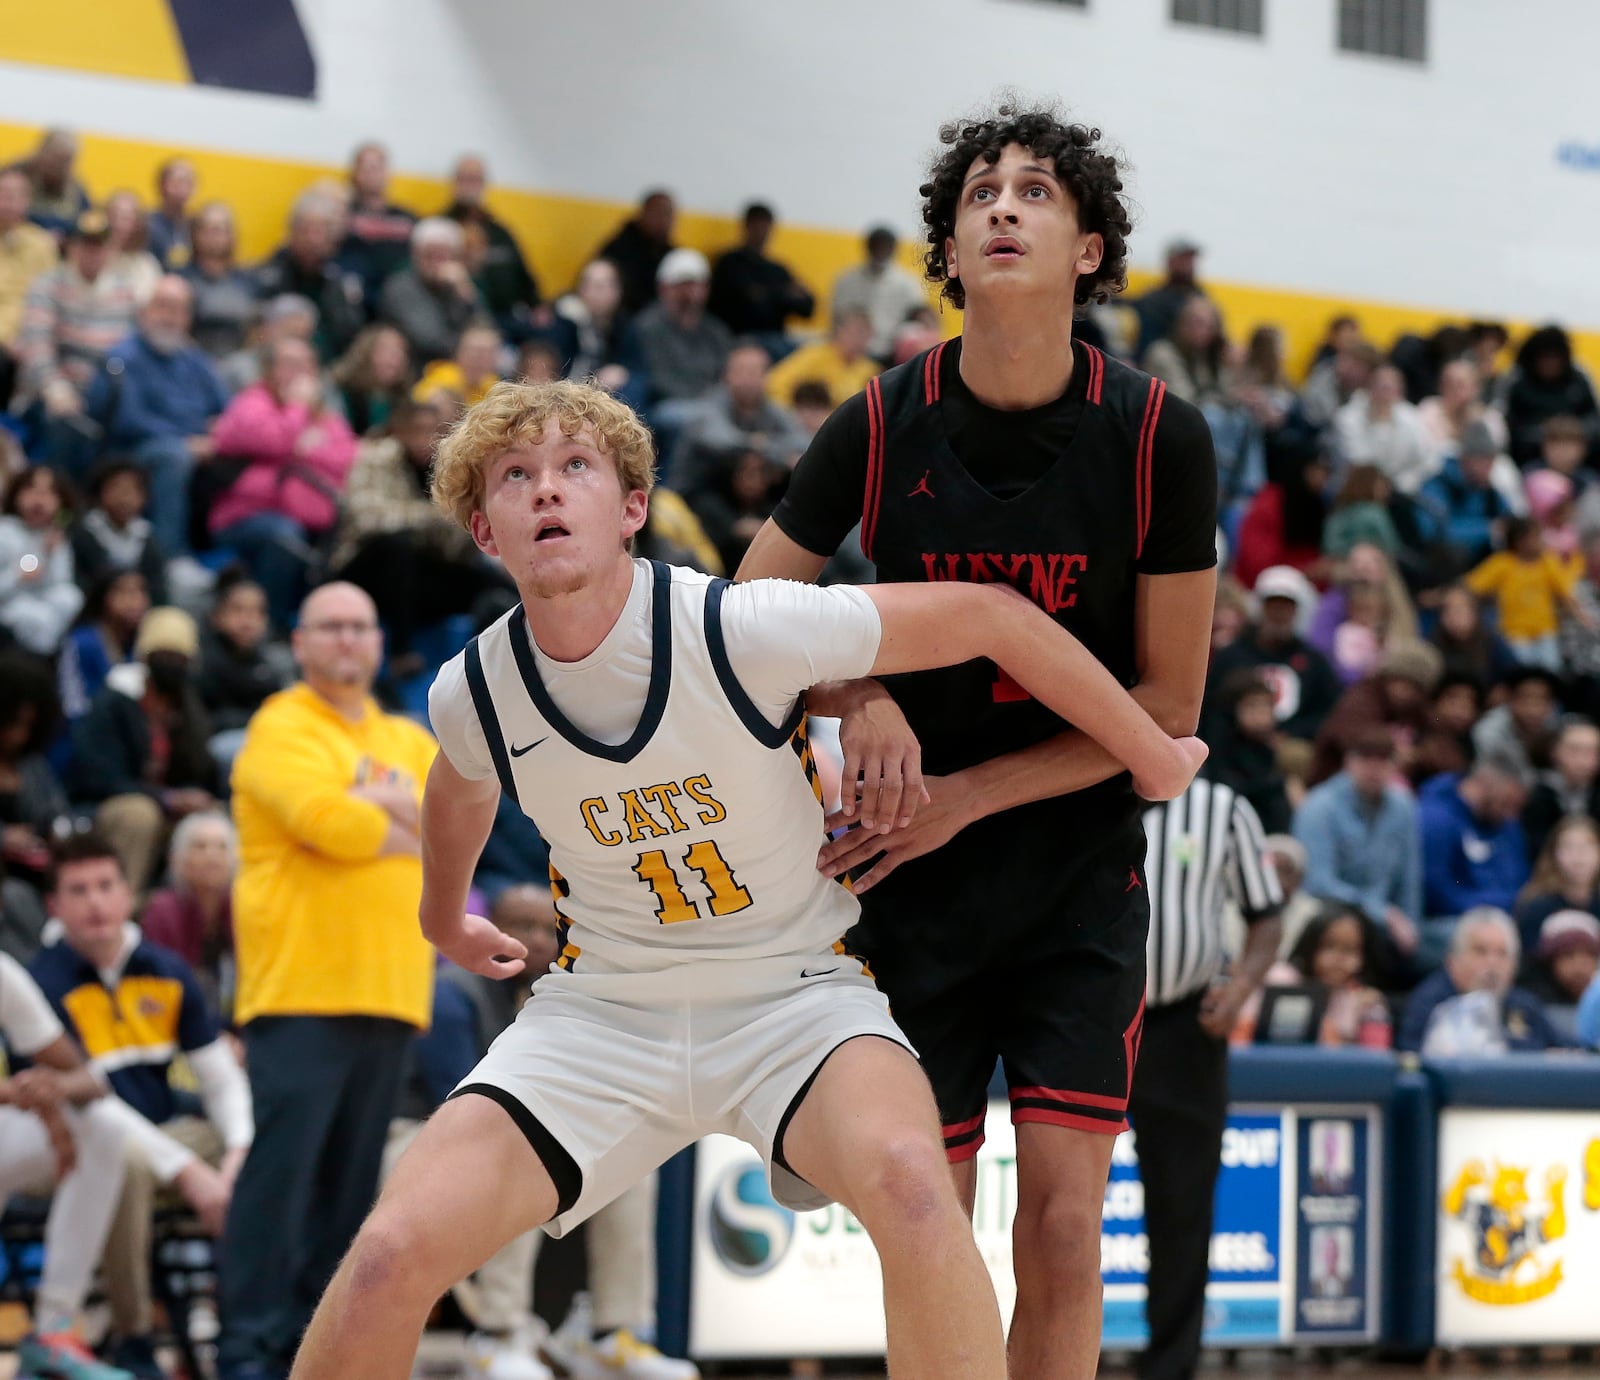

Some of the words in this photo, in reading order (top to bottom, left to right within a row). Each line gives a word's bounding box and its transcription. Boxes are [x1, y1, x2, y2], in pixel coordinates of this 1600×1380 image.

[921, 553, 1088, 613] WAYNE
[580, 773, 727, 846] CATS
[631, 839, 754, 924] 11
